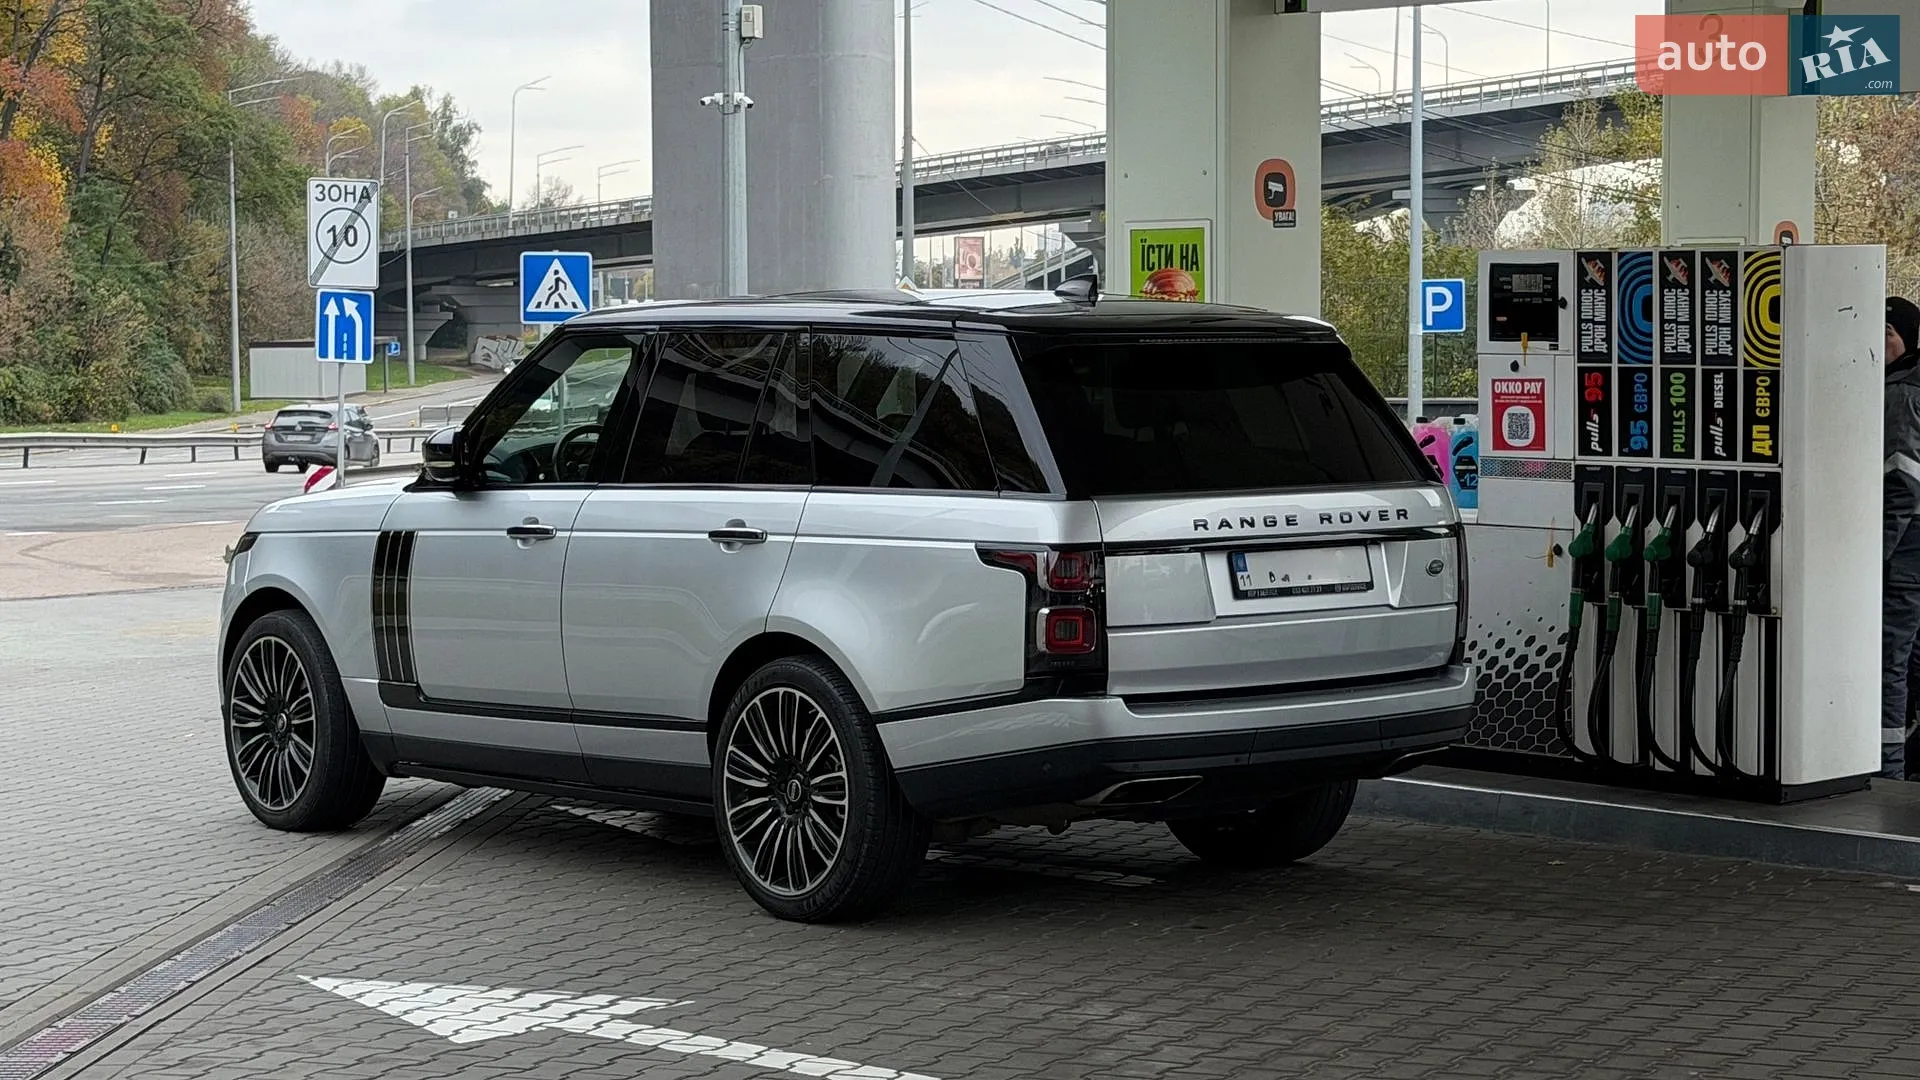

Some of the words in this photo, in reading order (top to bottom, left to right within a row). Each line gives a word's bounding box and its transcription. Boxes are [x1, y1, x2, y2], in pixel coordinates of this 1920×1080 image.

[315, 183, 372, 203] ЗОНА
[326, 224, 358, 247] 10
[1140, 238, 1174, 272] ЇСТИ
[1179, 243, 1200, 272] НА
[1425, 286, 1453, 326] P
[1581, 288, 1594, 319] ПЛЮС
[1594, 288, 1606, 322] МІНУС
[1663, 288, 1677, 320] ПЛЮС
[1677, 288, 1690, 322] МІНУС
[1705, 289, 1718, 321] ПЛЮС
[1718, 289, 1732, 323] МІНУС
[1581, 322, 1594, 353] PULLS
[1594, 324, 1608, 354] ДРОН
[1663, 322, 1677, 353] PULLS
[1677, 324, 1691, 354] ДРОН
[1705, 324, 1718, 355] PULLS
[1718, 326, 1733, 356] ДРОН
[1494, 381, 1523, 394] OKKO
[1523, 381, 1543, 394] PAY
[1584, 371, 1604, 402] 95
[1633, 372, 1648, 413] ЄВРО
[1669, 372, 1686, 406] 100
[1713, 372, 1724, 408] DIESEL
[1755, 375, 1771, 418] ЄВРО
[1586, 413, 1603, 452] pulls
[1629, 420, 1649, 450] 95
[1672, 409, 1686, 453] PULLS
[1709, 416, 1727, 457] pulls
[1751, 424, 1773, 456] ДП
[1193, 514, 1299, 531] RANGE
[1318, 508, 1410, 525] ROVER
